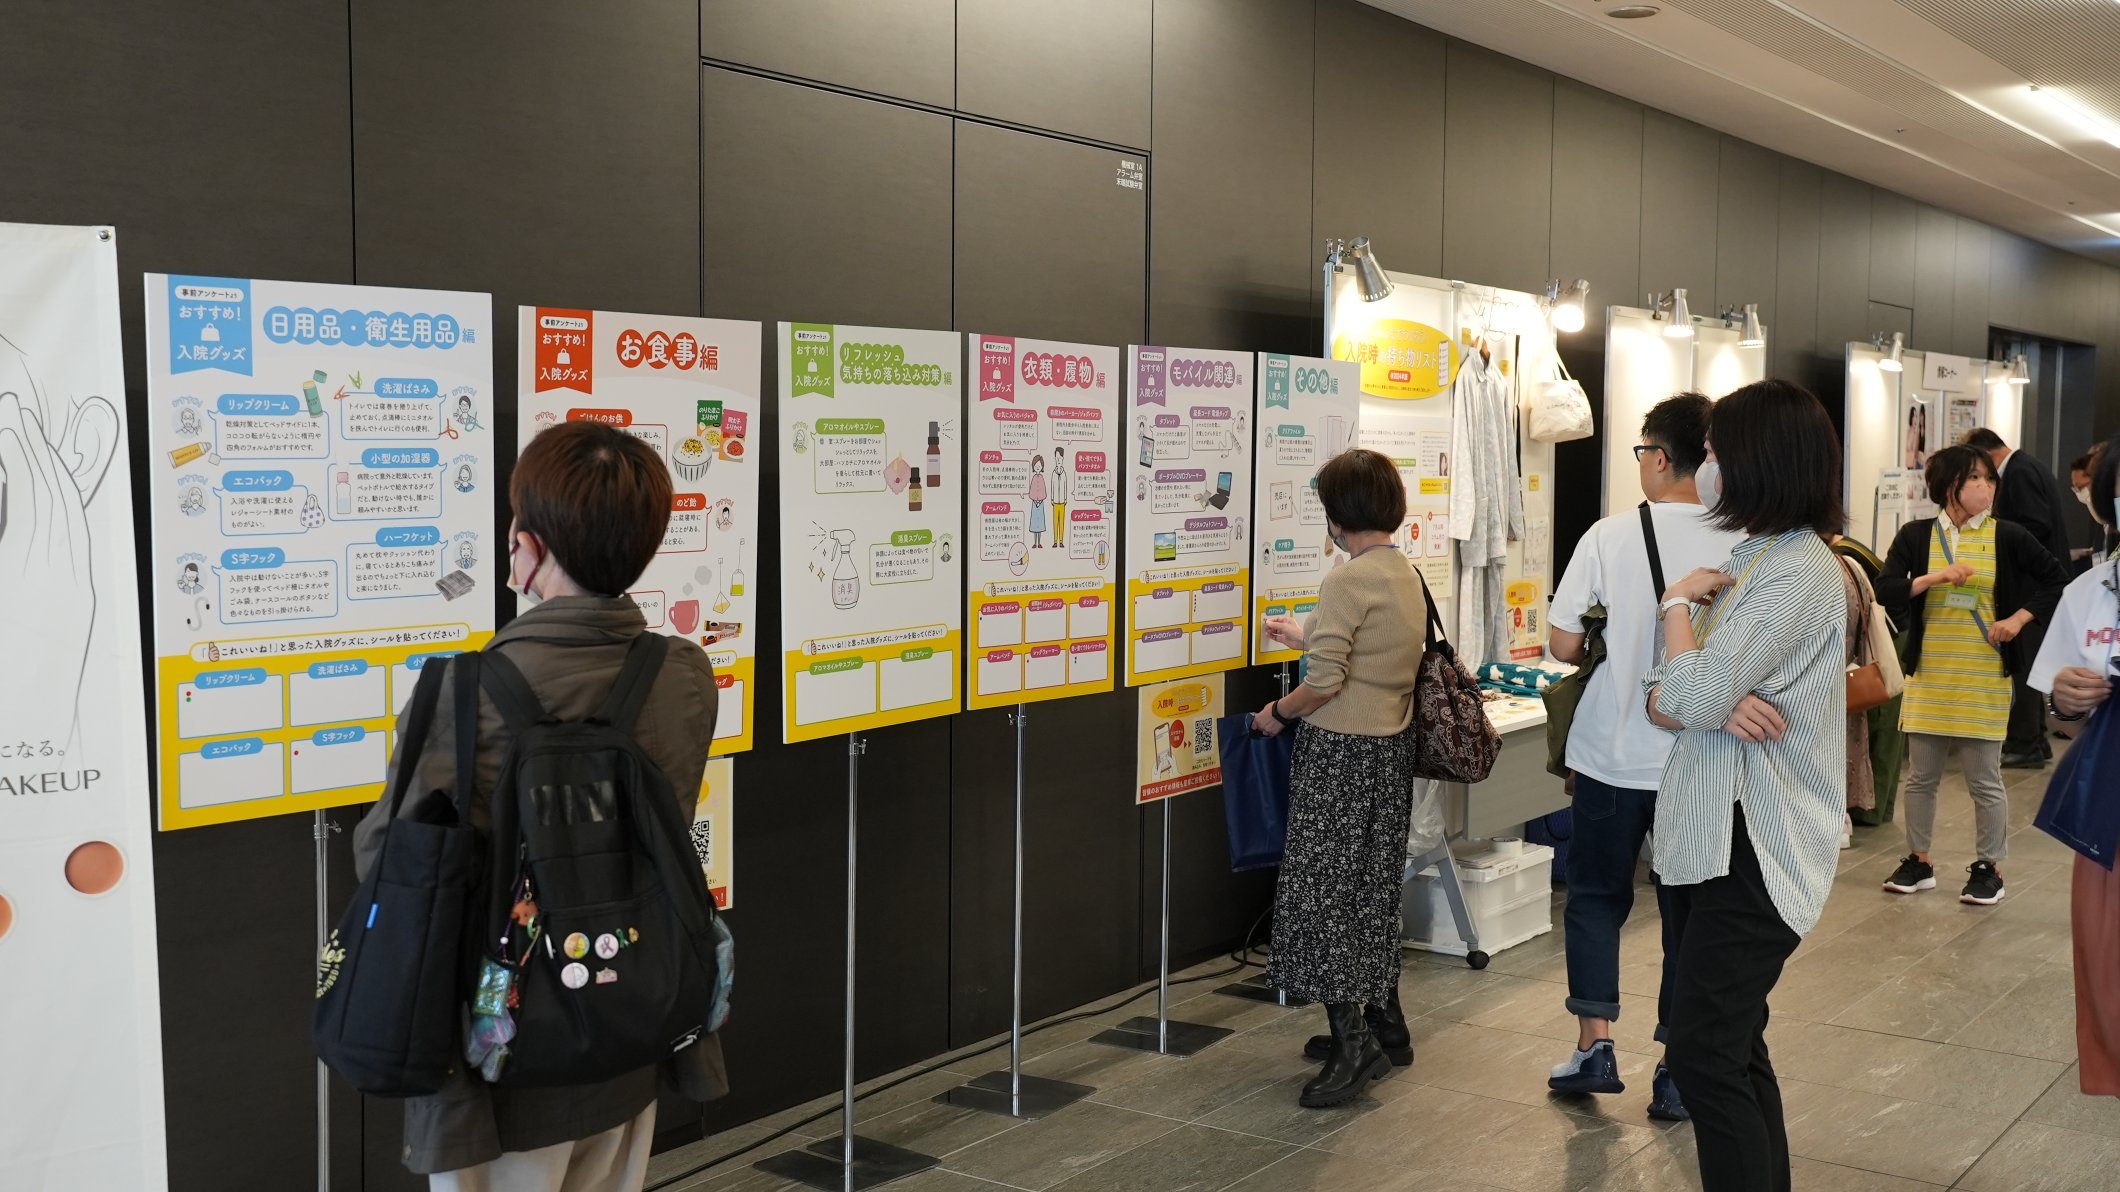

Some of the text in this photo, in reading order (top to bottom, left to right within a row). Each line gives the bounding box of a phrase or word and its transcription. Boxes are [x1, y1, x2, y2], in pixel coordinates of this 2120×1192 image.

[178, 305, 241, 321] おすすめ！
[542, 333, 586, 347] おすすめ！
[176, 345, 246, 361] 入院グッズ
[843, 349, 901, 362] リフレッシュ
[539, 368, 588, 381] 入院グッズ
[795, 376, 831, 387] 入院グッズ
[982, 382, 1012, 393] 入院グッズ
[381, 383, 431, 395] 洗濯ばさみ
[228, 399, 290, 410] リップクリーム
[823, 422, 880, 431] アロマオイルやスプレー
[370, 452, 431, 464] 小型の加湿器
[230, 496, 294, 505] 入浴や洗濯に使える
[676, 498, 697, 508] のど飴
[230, 508, 294, 516] レジャーシート素材の
[384, 531, 433, 543] ハーフケット
[231, 552, 276, 566] S字フック
[316, 663, 359, 676] 洗濯ばさみ
[205, 672, 256, 686] リップクリーム
[322, 730, 356, 743] S字フック
